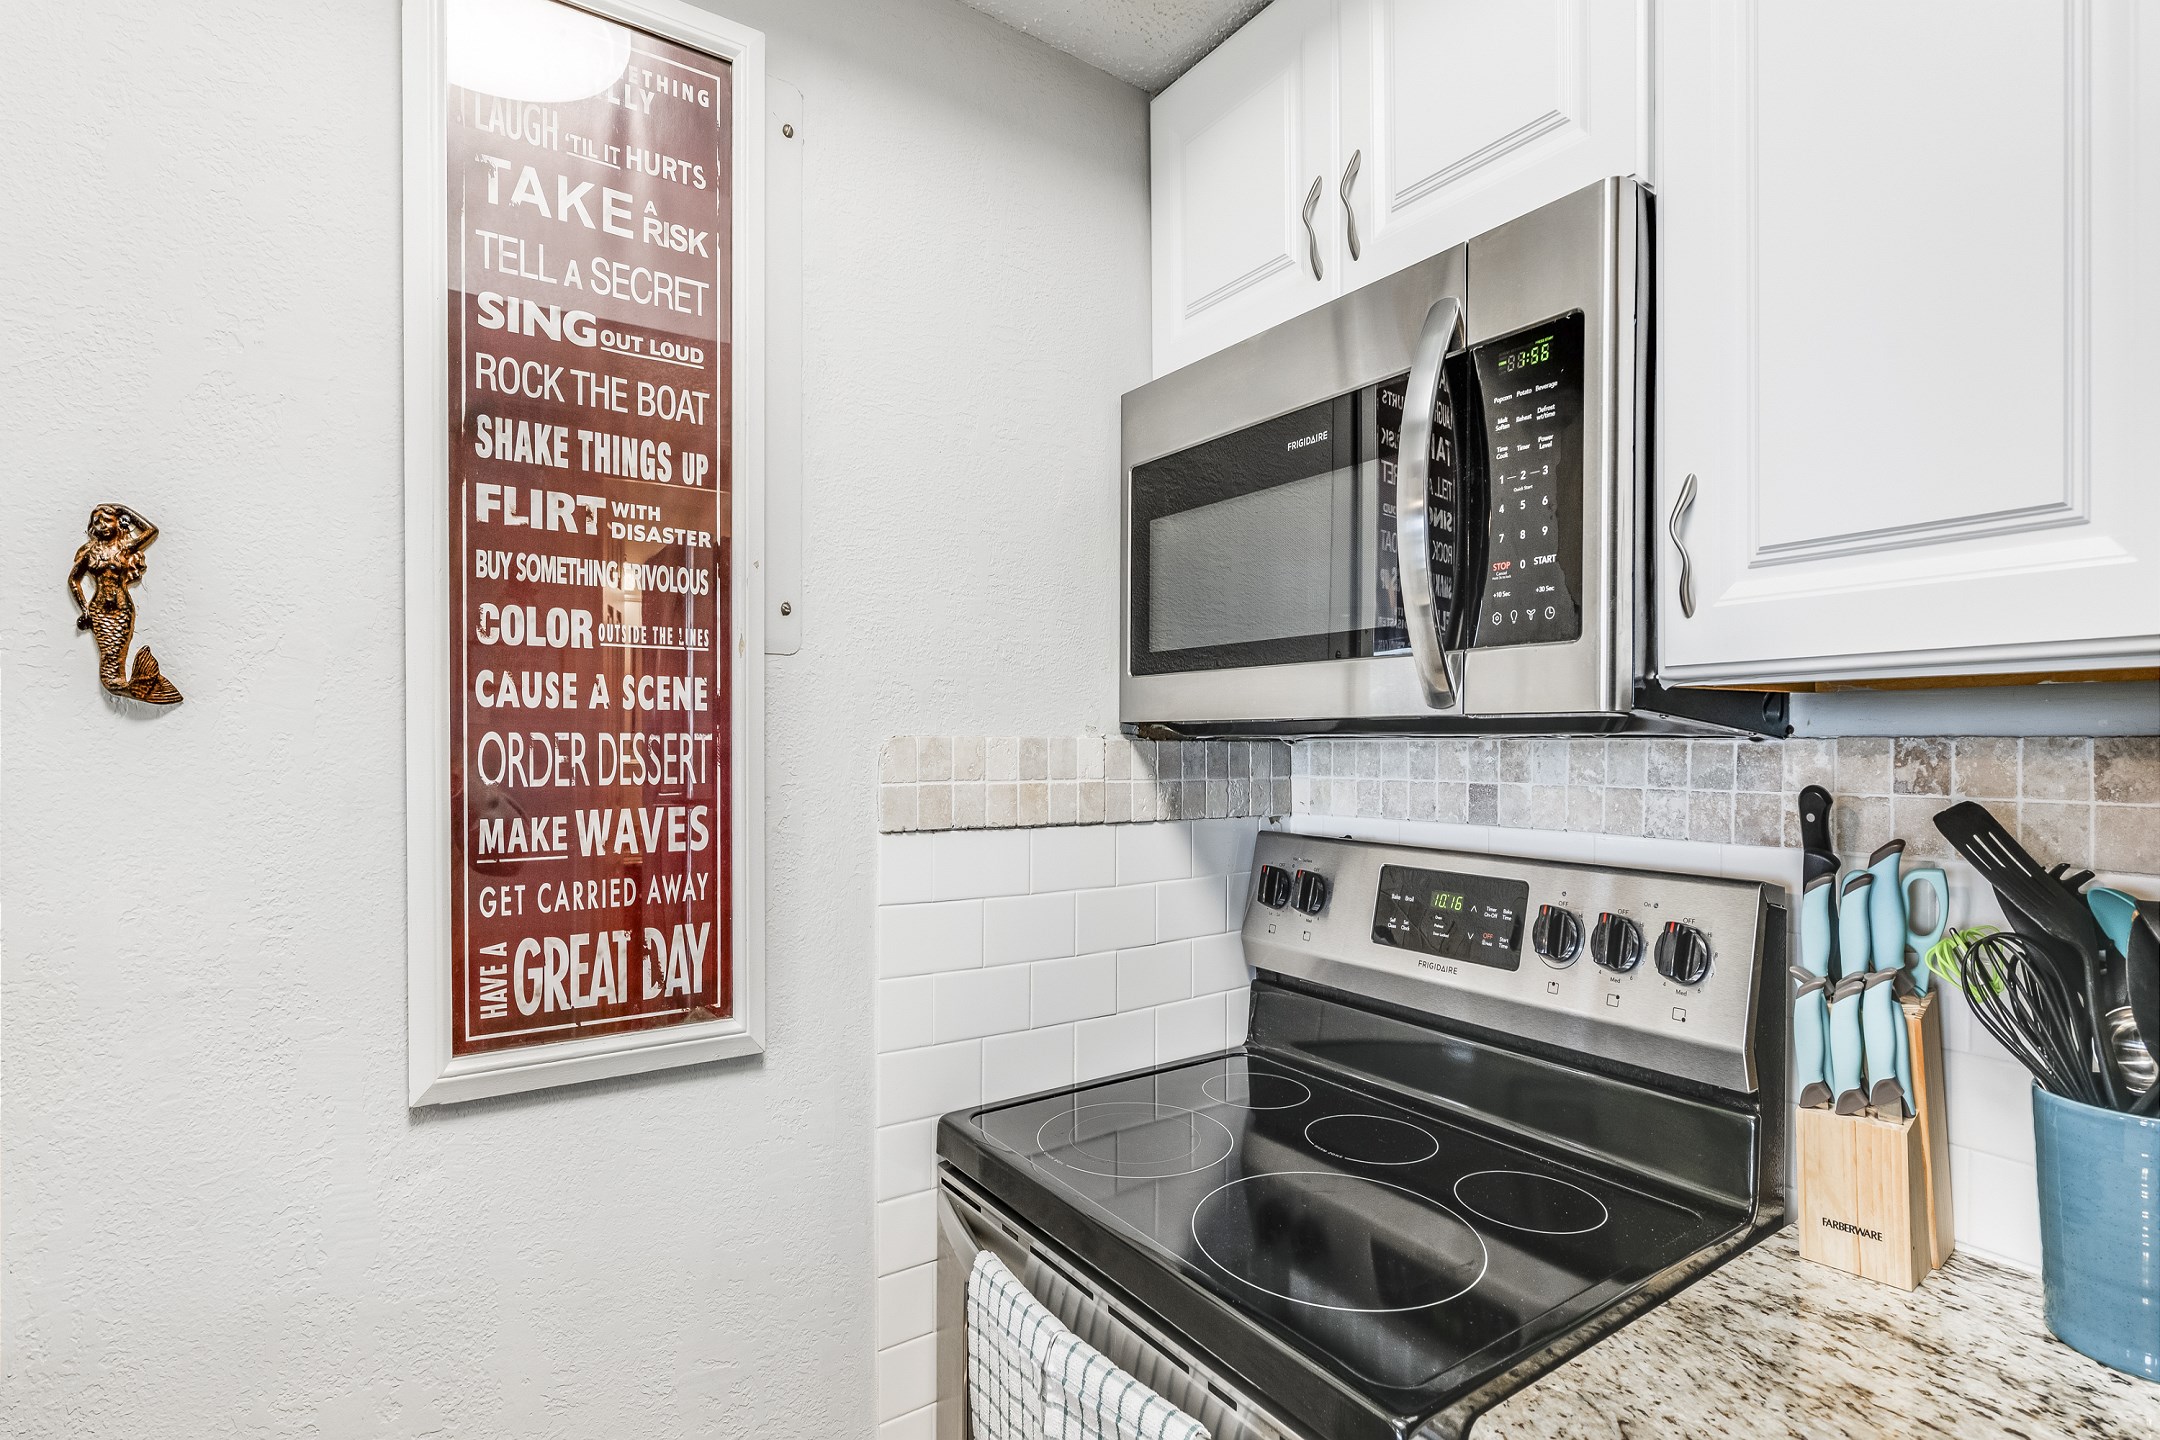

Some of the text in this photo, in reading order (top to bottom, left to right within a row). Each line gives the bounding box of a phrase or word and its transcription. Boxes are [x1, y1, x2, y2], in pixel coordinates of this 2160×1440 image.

[475, 101, 558, 151] LAUGH
[604, 144, 621, 165] IT
[626, 145, 707, 190] HURTS
[475, 154, 658, 240] TAKE A
[643, 216, 709, 259] RISK
[475, 229, 710, 317] TELL A SECRET
[477, 291, 704, 364] SING OUT LOUD
[475, 352, 710, 426] ROCK THE BOAT
[1493, 381, 1558, 404] Popcorn Potato Beverage
[1537, 404, 1556, 414] Defrost
[474, 414, 709, 486] SHAKE THINGS UP
[1287, 430, 1328, 451] FRIGIDAIRE
[1516, 443, 1531, 451] Timer
[1538, 434, 1554, 443] Power
[1539, 440, 1553, 450] Level
[1495, 452, 1508, 460] Cook
[1499, 465, 1549, 485] 1 2 3
[475, 482, 661, 536] FLIRT WITH
[1498, 495, 1548, 514] 4 5 6
[611, 521, 712, 548] DISASTER
[1499, 525, 1548, 543] 7 8 9
[475, 549, 513, 580] BUY
[516, 552, 618, 589] SOMETHING
[1492, 561, 1511, 571] STOP
[1519, 559, 1526, 569] 0
[1533, 553, 1557, 565] START
[475, 602, 709, 649] COLOR OUTSIDE THE LINES
[475, 669, 708, 712] CAUSE A SCENE
[477, 731, 713, 788] ORDER DESSERT
[478, 805, 710, 857] MAKE WAVES
[479, 872, 709, 918] GET CARRIED AWAY
[479, 941, 508, 1020] HAVE A
[513, 921, 711, 1017] GREAT DAY
[1417, 960, 1458, 975] FRIGIDAIRE
[1610, 976, 1621, 984] Med
[1822, 1217, 1883, 1242] FARBERWARE
